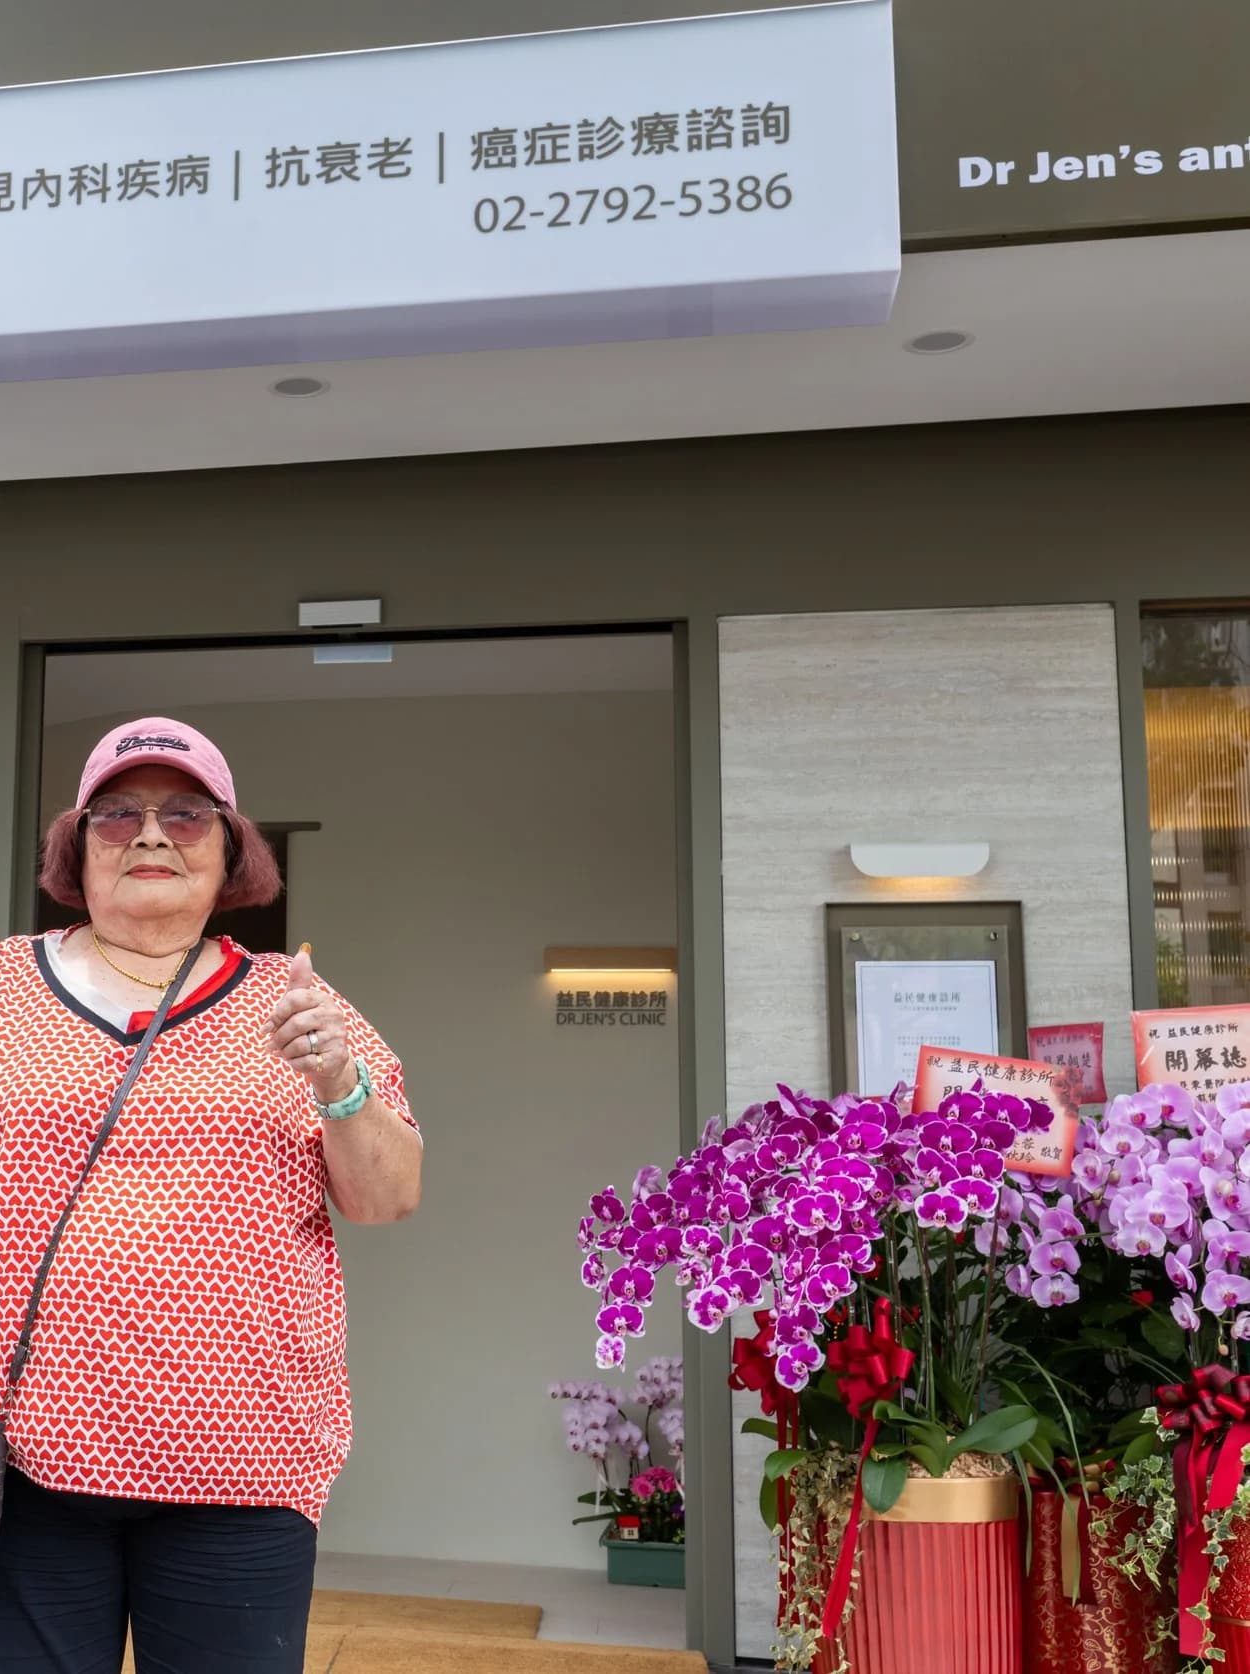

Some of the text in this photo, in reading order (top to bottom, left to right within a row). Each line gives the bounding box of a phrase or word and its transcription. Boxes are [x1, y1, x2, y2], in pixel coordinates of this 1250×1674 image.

[265, 136, 413, 189] 抗衰老
[470, 101, 791, 171] 癌症診療諮詢
[958, 156, 1014, 187] Dr
[1028, 145, 1163, 183] Jen’s
[473, 172, 793, 234] 02-2792-5386
[556, 990, 667, 1008] 益民健康診所
[619, 1012, 666, 1025] CLINIC
[1148, 1023, 1238, 1039] 祝 益民健康診所
[926, 1055, 1055, 1087] 祝 益民健康診所
[1165, 1045, 1248, 1073] 開幕誌
